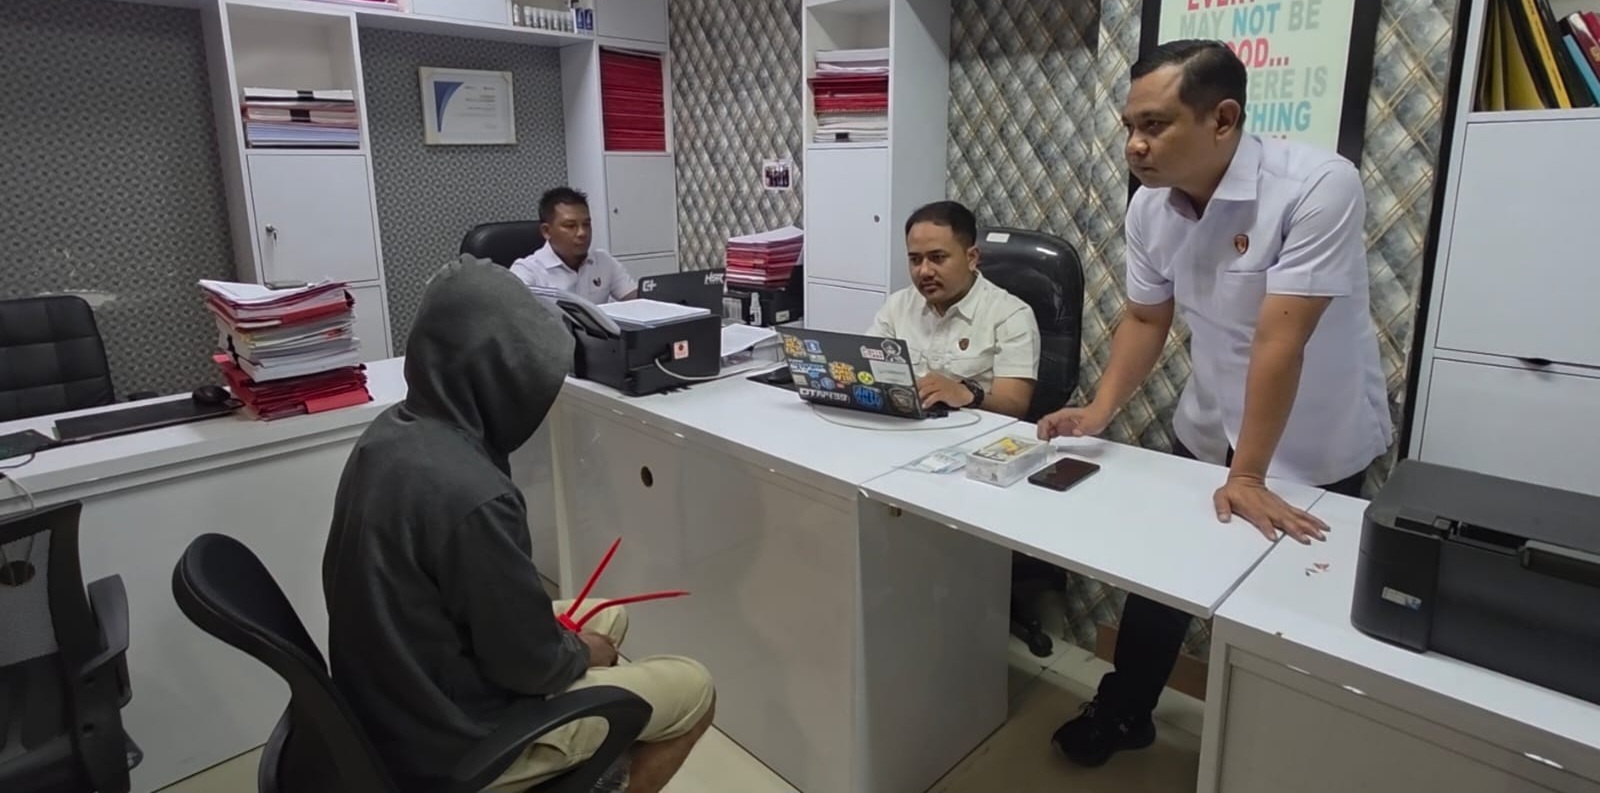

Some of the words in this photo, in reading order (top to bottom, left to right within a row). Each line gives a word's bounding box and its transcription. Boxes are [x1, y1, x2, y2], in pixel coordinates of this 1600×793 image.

[1180, 10, 1225, 39] MAY
[1232, 3, 1280, 37] NOT
[1288, 0, 1322, 31] BE
[1248, 68, 1296, 101] ERE
[1303, 66, 1328, 98] IS
